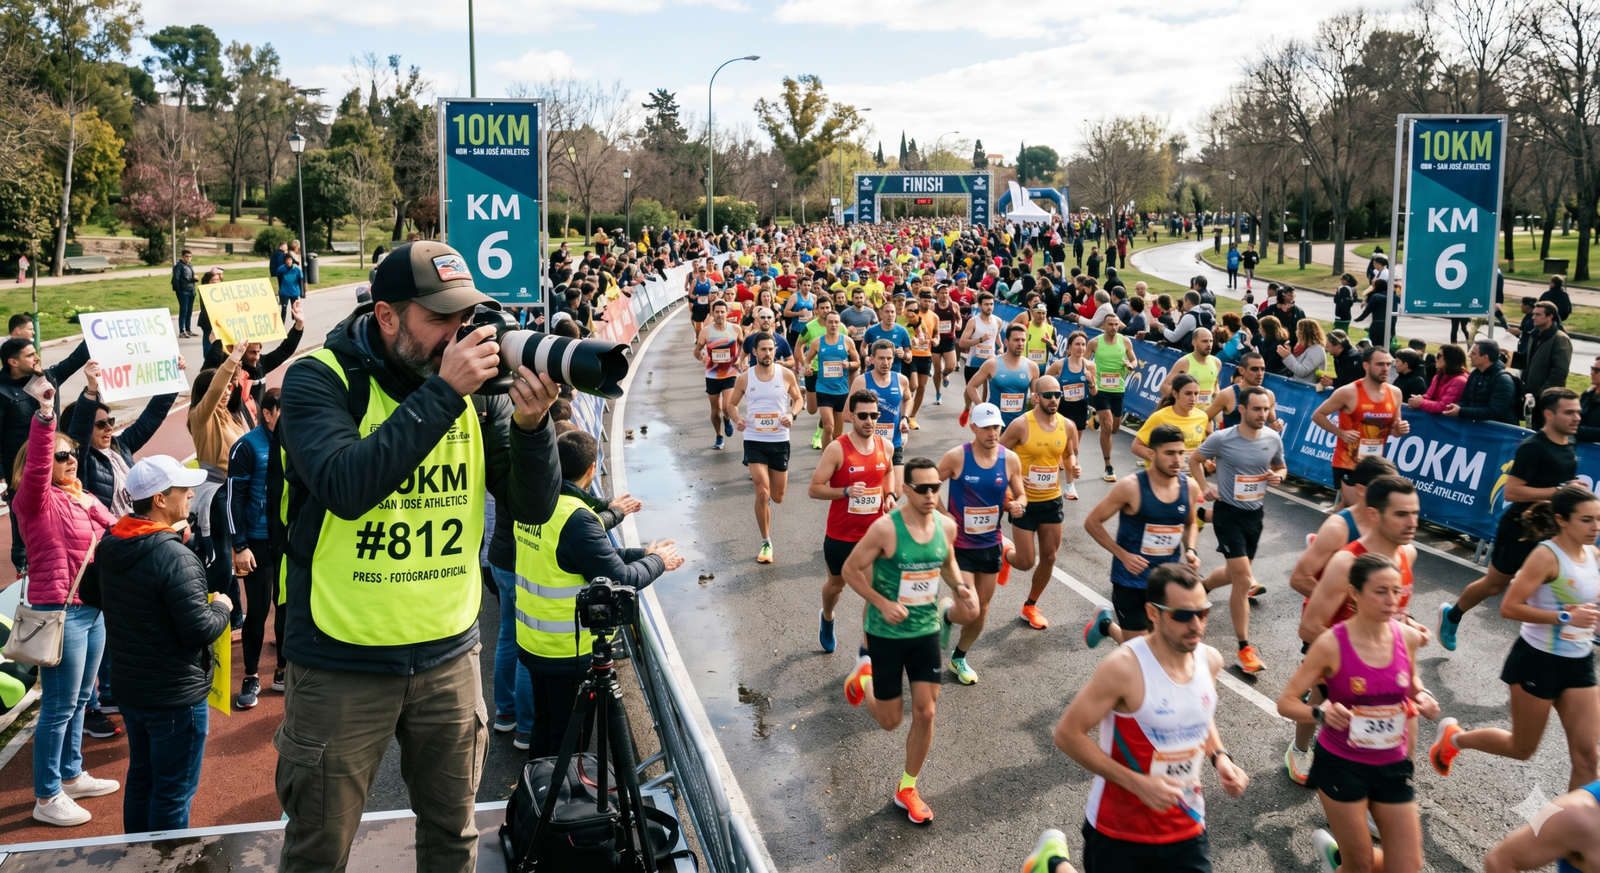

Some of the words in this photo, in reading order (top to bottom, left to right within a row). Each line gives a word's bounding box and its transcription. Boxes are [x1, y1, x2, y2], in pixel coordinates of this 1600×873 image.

[452, 113, 530, 146] 10KM
[486, 146, 499, 156] JOSÉ
[500, 148, 530, 156] ATHLETICS
[1419, 130, 1492, 161] 10KM
[1449, 161, 1462, 170] JOSÉ
[903, 177, 944, 192] FINISH
[467, 194, 520, 220] KM
[1427, 207, 1478, 233] KM
[477, 231, 512, 280] 6
[1435, 244, 1468, 290] 6
[236, 301, 250, 313] NO
[91, 315, 167, 340] CHEERIAS
[101, 364, 131, 391] NOT
[1386, 435, 1487, 491] 10KM
[396, 463, 467, 495] 0KM
[379, 499, 397, 509] SAN
[400, 496, 422, 509] JOSÉ
[424, 495, 468, 509] ATHLETICS
[1414, 481, 1434, 493] JOSÉ
[1432, 486, 1475, 505] ATHLETICS
[356, 518, 463, 560] #812
[353, 571, 382, 583] PRESS
[390, 569, 439, 583] FOTÓGRAFO
[441, 565, 467, 578] OFICIAL
